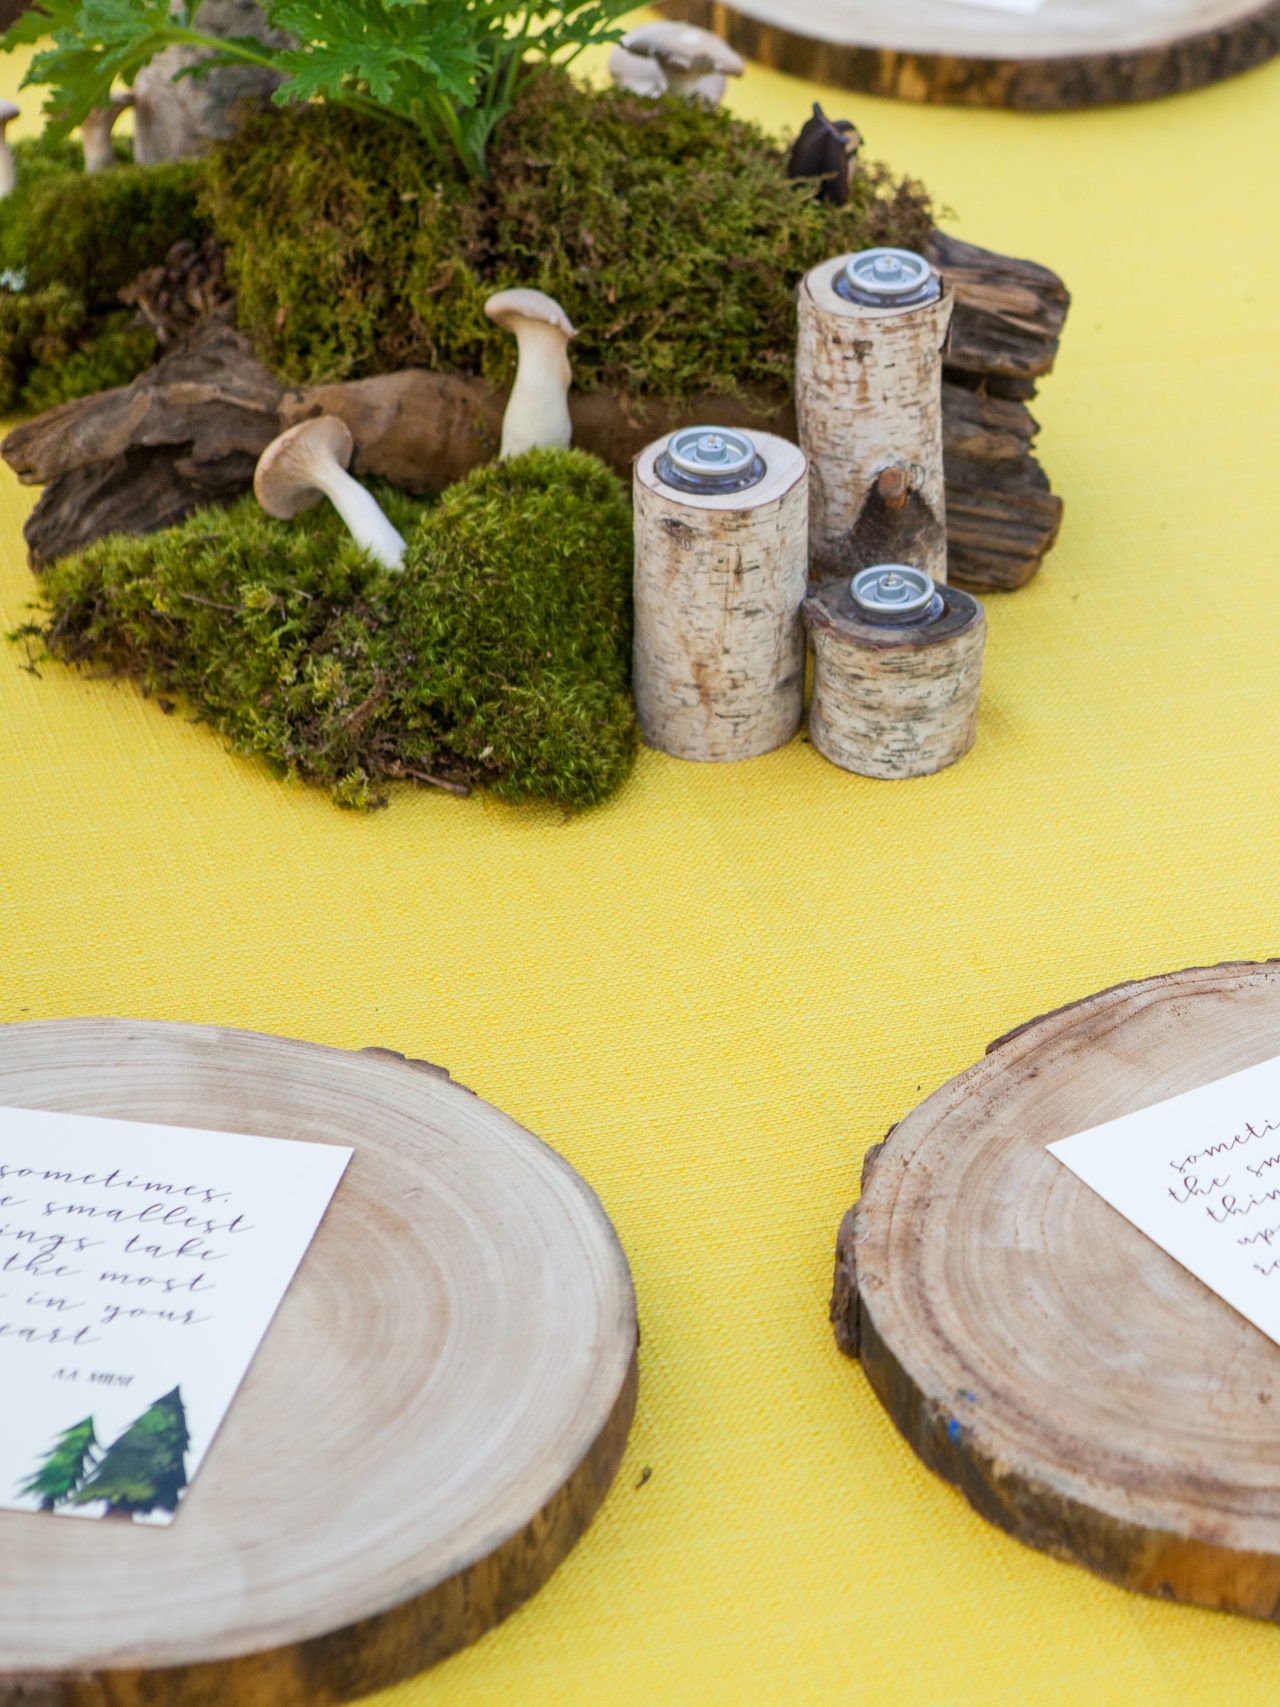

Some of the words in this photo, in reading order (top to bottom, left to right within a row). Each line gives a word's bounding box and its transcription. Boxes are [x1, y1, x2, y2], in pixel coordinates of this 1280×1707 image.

[1168, 1174, 1231, 1203] the
[41, 1201, 255, 1233] smallest
[124, 1234, 228, 1261] take
[3, 1252, 83, 1276] the
[99, 1273, 216, 1293] most
[26, 1291, 85, 1311] in
[100, 1304, 213, 1325] your
[0, 1324, 102, 1345] eart
